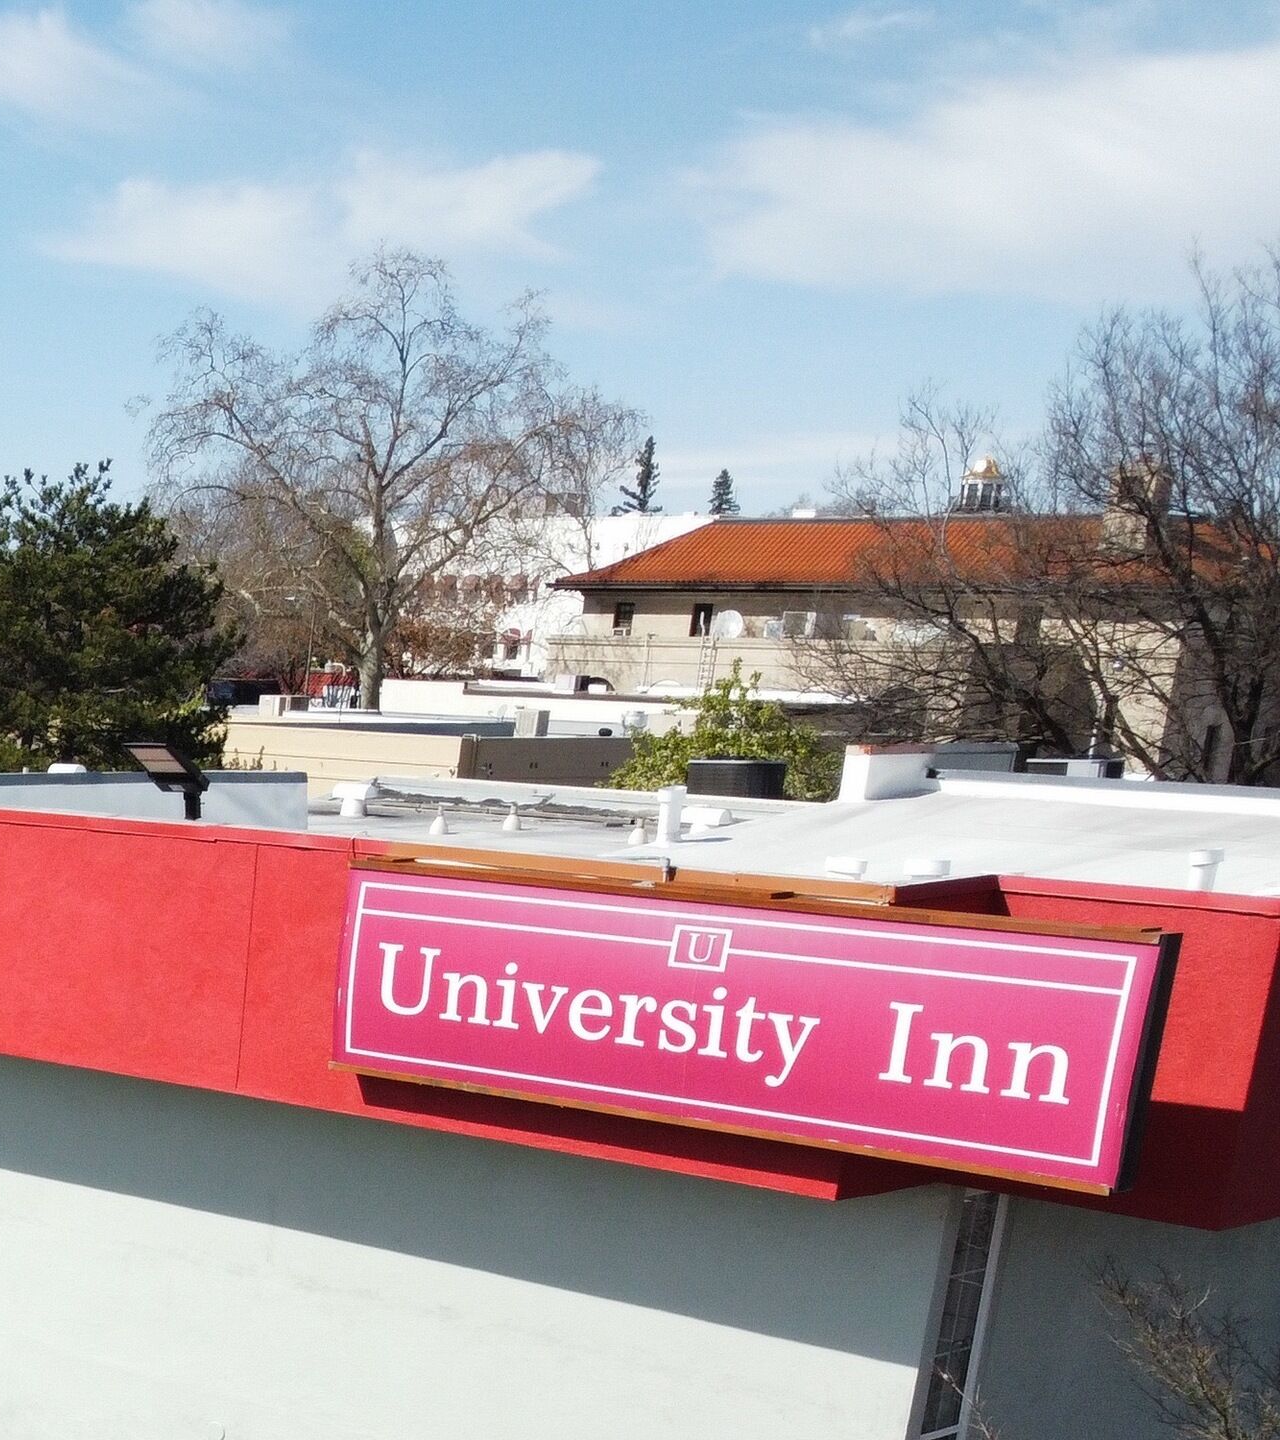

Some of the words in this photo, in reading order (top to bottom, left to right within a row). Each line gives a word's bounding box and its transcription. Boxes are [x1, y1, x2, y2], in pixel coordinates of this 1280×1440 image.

[689, 933, 718, 963] U
[378, 942, 821, 1087] University
[878, 1002, 1070, 1105] Inn
